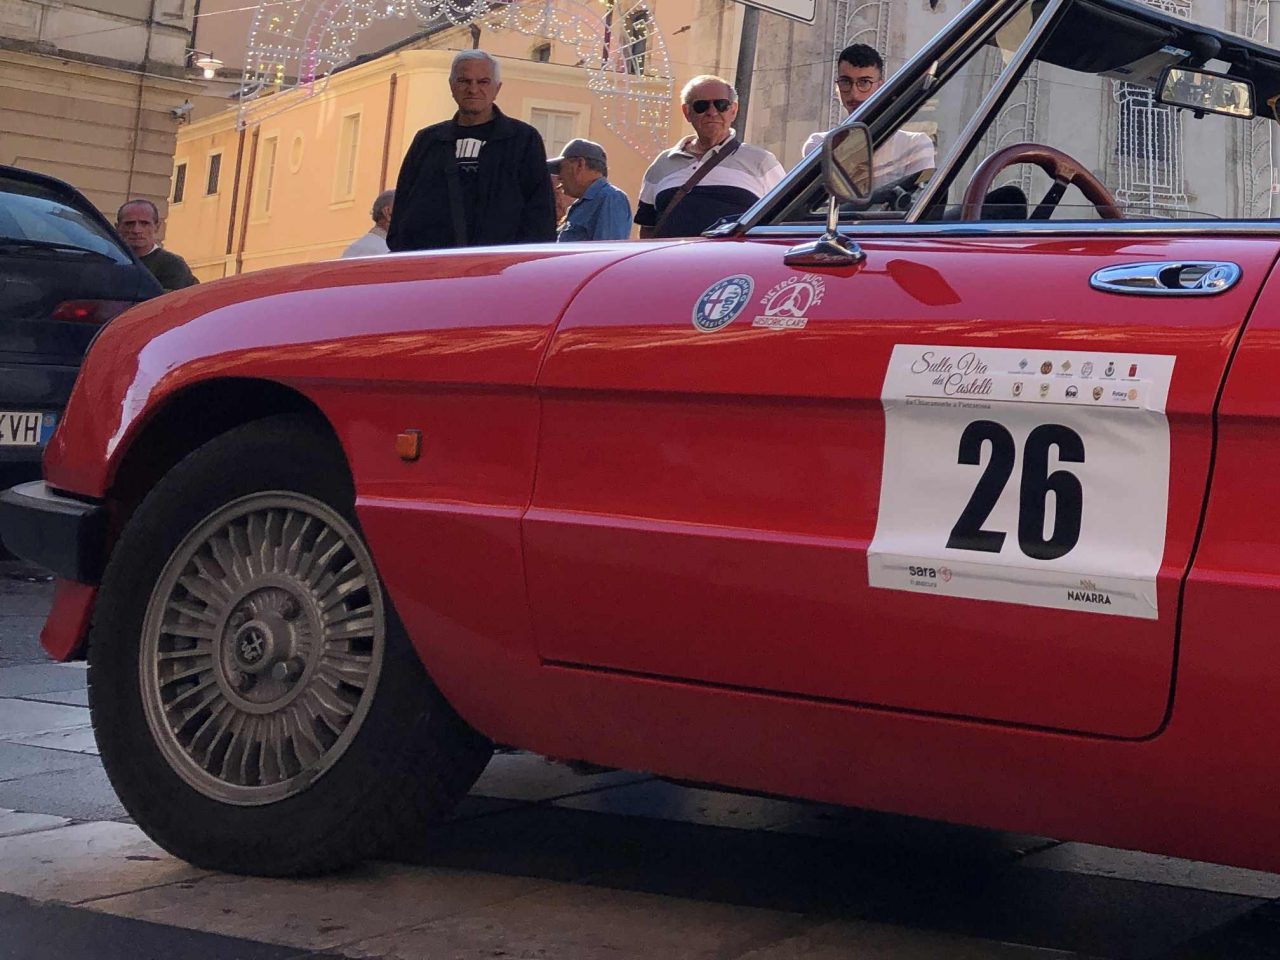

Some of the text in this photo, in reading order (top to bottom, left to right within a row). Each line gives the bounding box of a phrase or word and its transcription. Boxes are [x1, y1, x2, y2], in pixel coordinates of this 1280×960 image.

[760, 275, 798, 305] PIETRO
[754, 317, 807, 327] HISTORIC CARS
[911, 351, 988, 376] Sulla Via
[943, 372, 993, 396] Castelli
[945, 419, 1086, 561] 26
[908, 565, 937, 579] sara
[1067, 590, 1112, 606] NAVARRA
